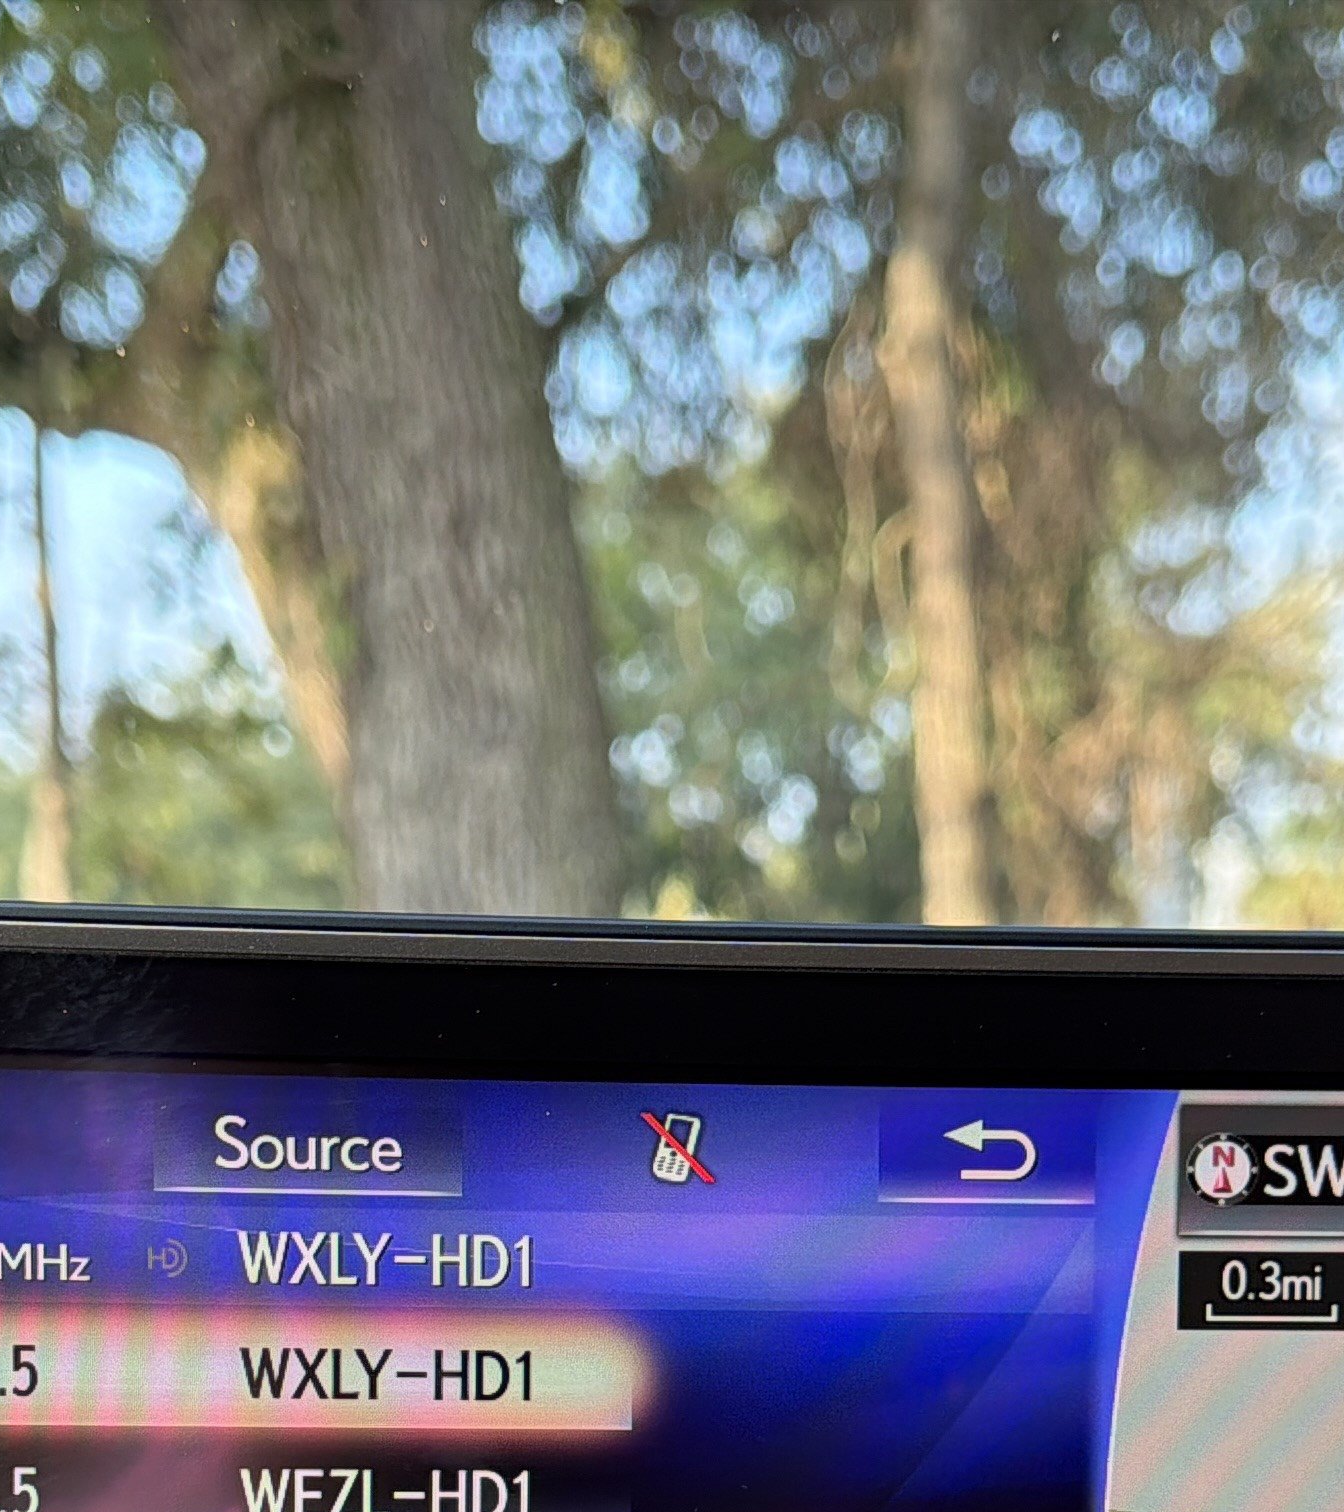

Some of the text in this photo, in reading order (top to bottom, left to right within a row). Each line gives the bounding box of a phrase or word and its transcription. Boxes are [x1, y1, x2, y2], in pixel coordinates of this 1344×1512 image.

[213, 1113, 404, 1174] Source
[237, 1229, 534, 1288] WXLY-HD1
[1221, 1258, 1324, 1301] 0.3mi
[239, 1347, 534, 1402] WXLY-HD1
